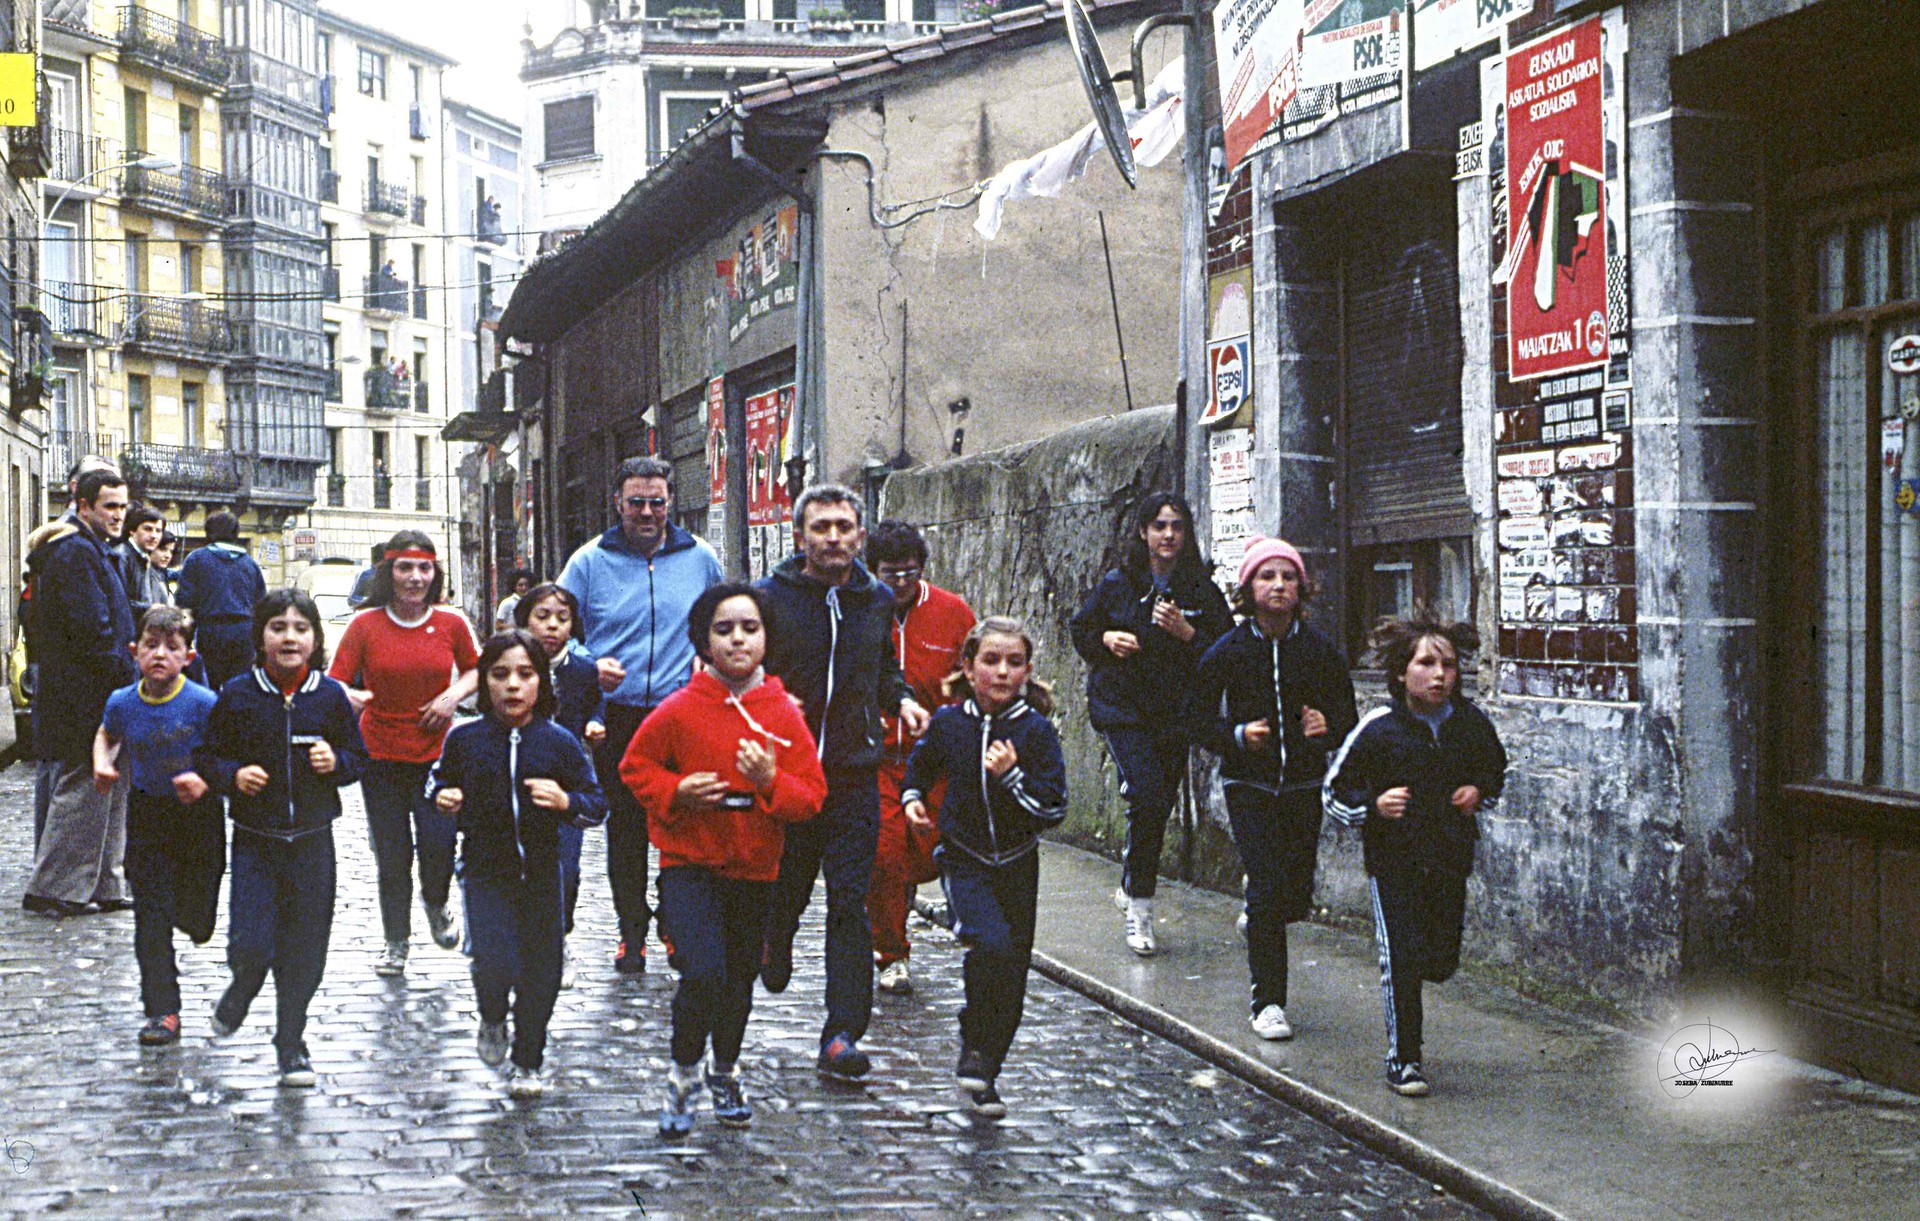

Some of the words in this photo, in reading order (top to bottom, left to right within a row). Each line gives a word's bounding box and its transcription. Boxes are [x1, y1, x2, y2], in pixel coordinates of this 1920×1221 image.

[1354, 33, 1383, 71] PSOE
[1528, 39, 1576, 77] EUSKADI
[1267, 59, 1297, 118] PSOE
[1508, 80, 1545, 109] ASKATUA
[1529, 89, 1578, 122] SOZIALISTA
[1518, 331, 1573, 360] MAIATZAK
[1573, 318, 1582, 350] 1
[1217, 369, 1242, 392] PEPSI
